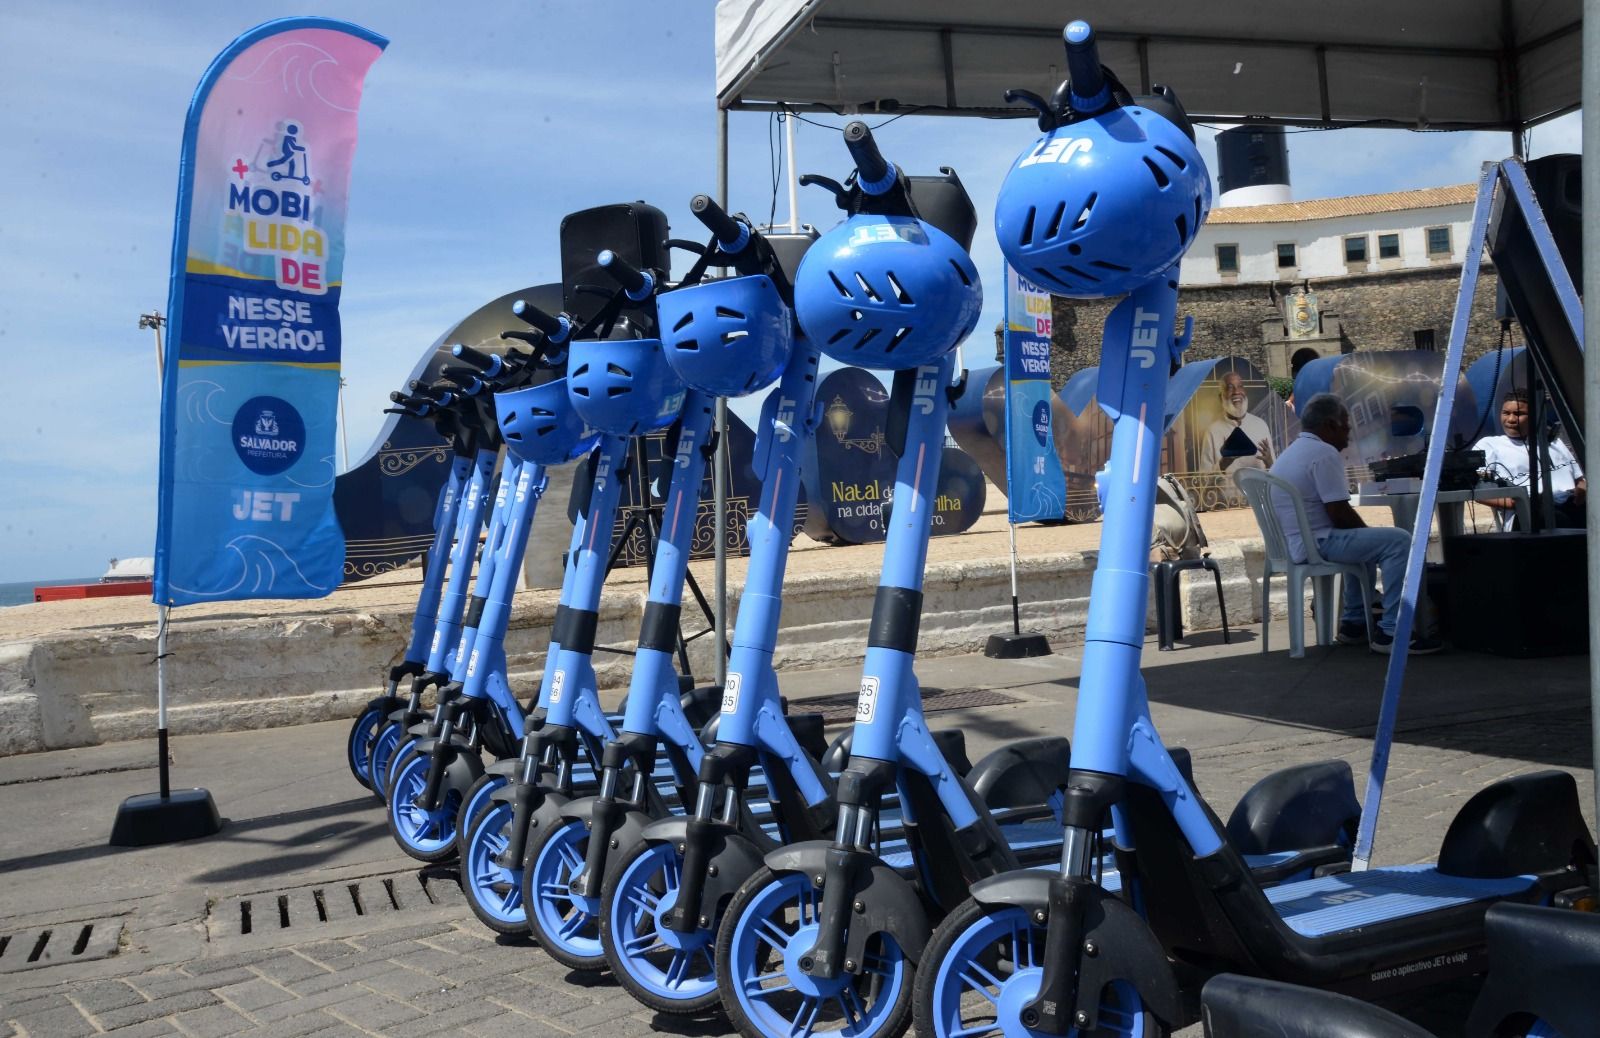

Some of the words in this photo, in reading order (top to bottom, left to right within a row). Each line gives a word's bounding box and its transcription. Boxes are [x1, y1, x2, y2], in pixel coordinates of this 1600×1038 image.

[1019, 137, 1094, 169] JET
[229, 183, 310, 221] MOBI
[248, 221, 323, 257] LIDA
[281, 257, 321, 289] DE
[1018, 274, 1049, 294] MO
[228, 296, 313, 324] NESSE
[221, 322, 326, 352] VERÃO!
[1131, 306, 1160, 369] JET
[1020, 356, 1050, 373] VERÃ
[774, 395, 797, 443] JET
[240, 436, 297, 452] SALVADOR
[247, 449, 288, 459] PREFEITURA
[677, 426, 696, 469] JET
[594, 452, 611, 489] JET
[443, 489, 454, 512] JET
[467, 482, 480, 510] JET
[496, 478, 510, 508] JET
[516, 469, 530, 503] JET
[831, 480, 880, 503] Natal
[232, 491, 300, 522] JET
[838, 505, 852, 518] na
[855, 501, 881, 517] cida
[858, 702, 870, 715] 53
[1321, 890, 1375, 905] JET
[1371, 969, 1392, 982] Baixe
[1392, 968, 1397, 977] o
[1398, 960, 1432, 977] aplicativo
[1433, 955, 1446, 968] JET
[1446, 956, 1451, 965] e
[1452, 952, 1468, 964] viaje
